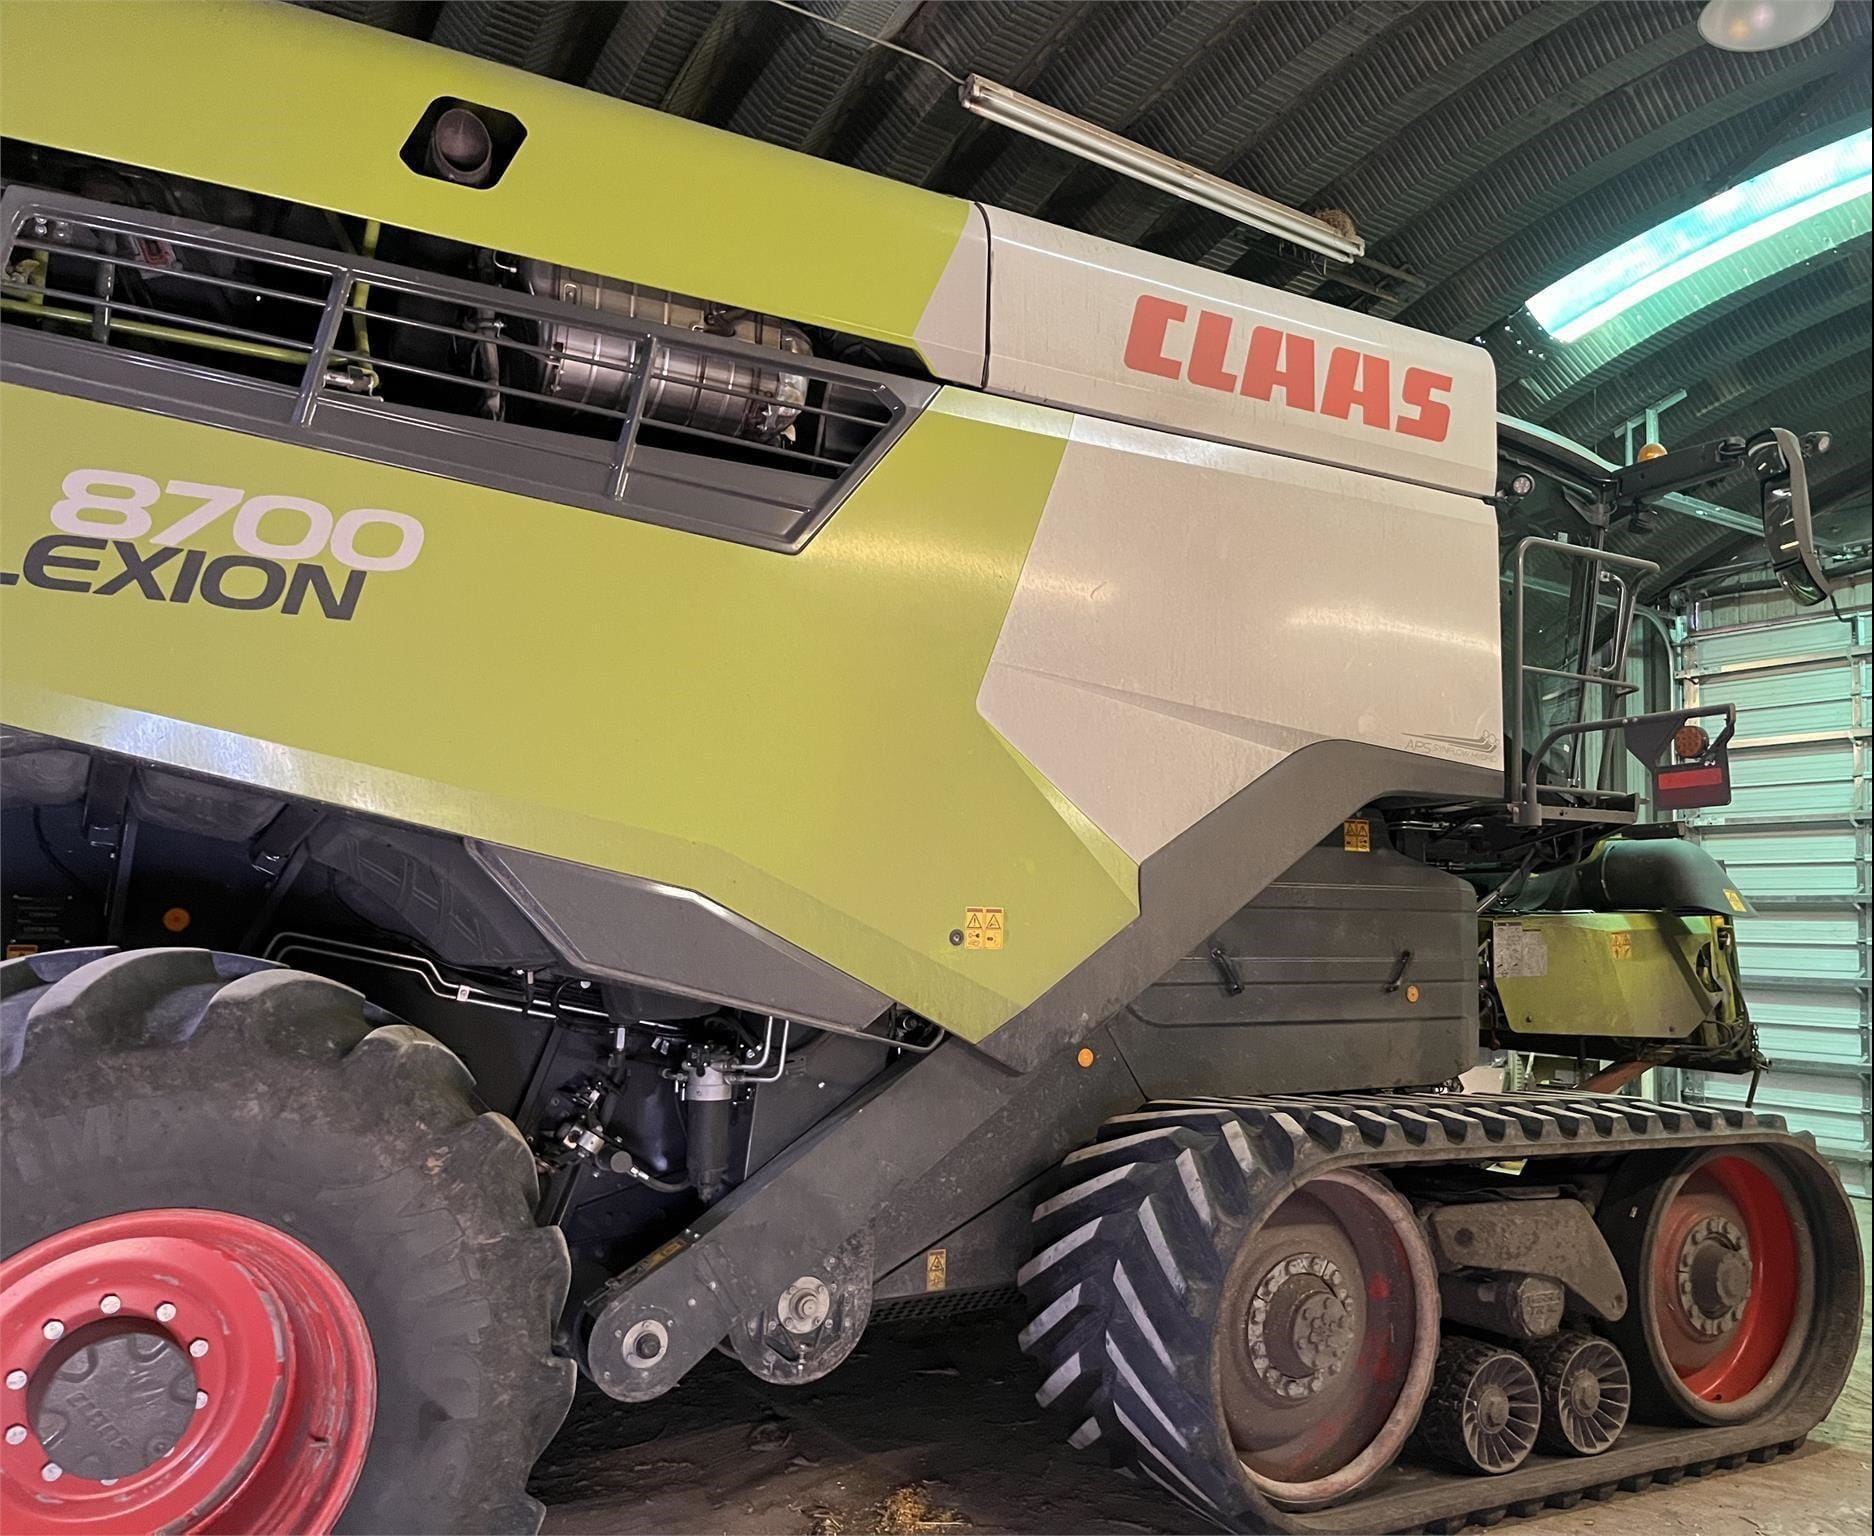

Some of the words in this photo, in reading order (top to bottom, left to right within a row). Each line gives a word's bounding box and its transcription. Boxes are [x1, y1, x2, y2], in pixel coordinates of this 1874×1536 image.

[1123, 294, 1453, 442] CLAAS
[50, 469, 425, 571] 8700
[0, 534, 367, 621] EXION
[1404, 739, 1432, 754] APS
